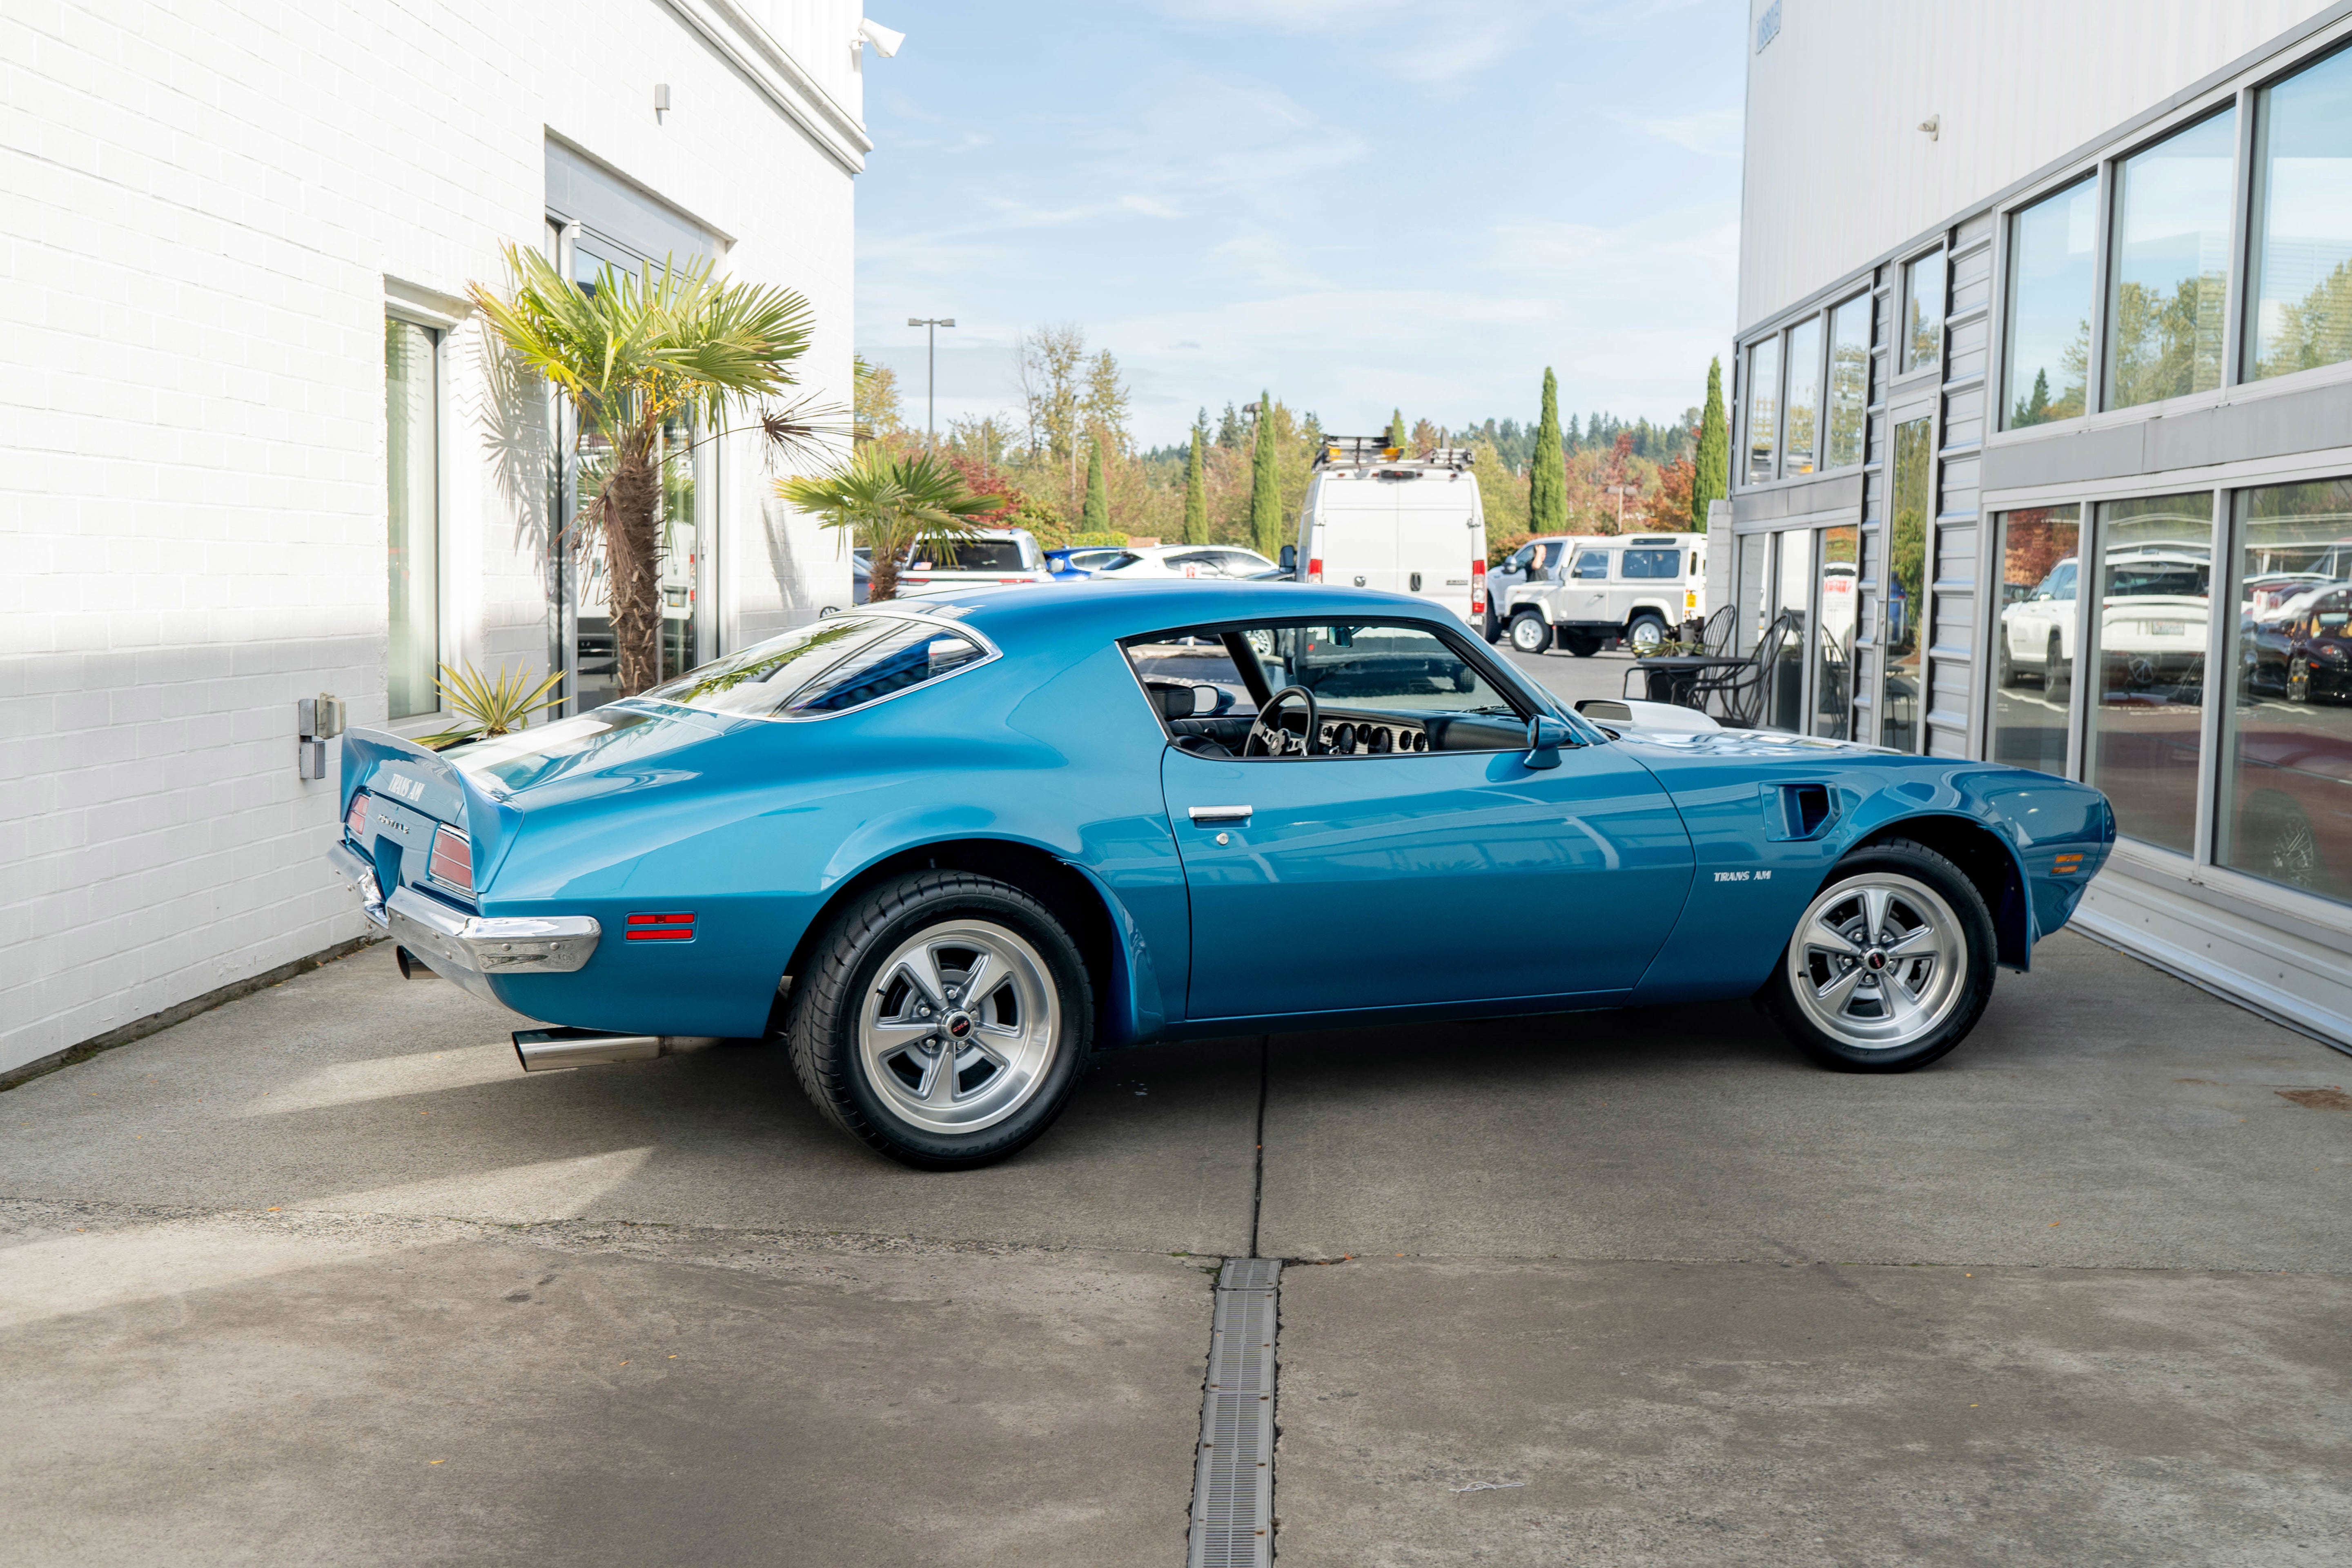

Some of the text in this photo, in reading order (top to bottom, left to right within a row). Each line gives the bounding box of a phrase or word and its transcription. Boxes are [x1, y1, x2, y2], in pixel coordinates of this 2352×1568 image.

[388, 773, 425, 802] TRANS AM
[378, 814, 411, 834] PONTIAC
[1714, 870, 1771, 882] TRANS AM
